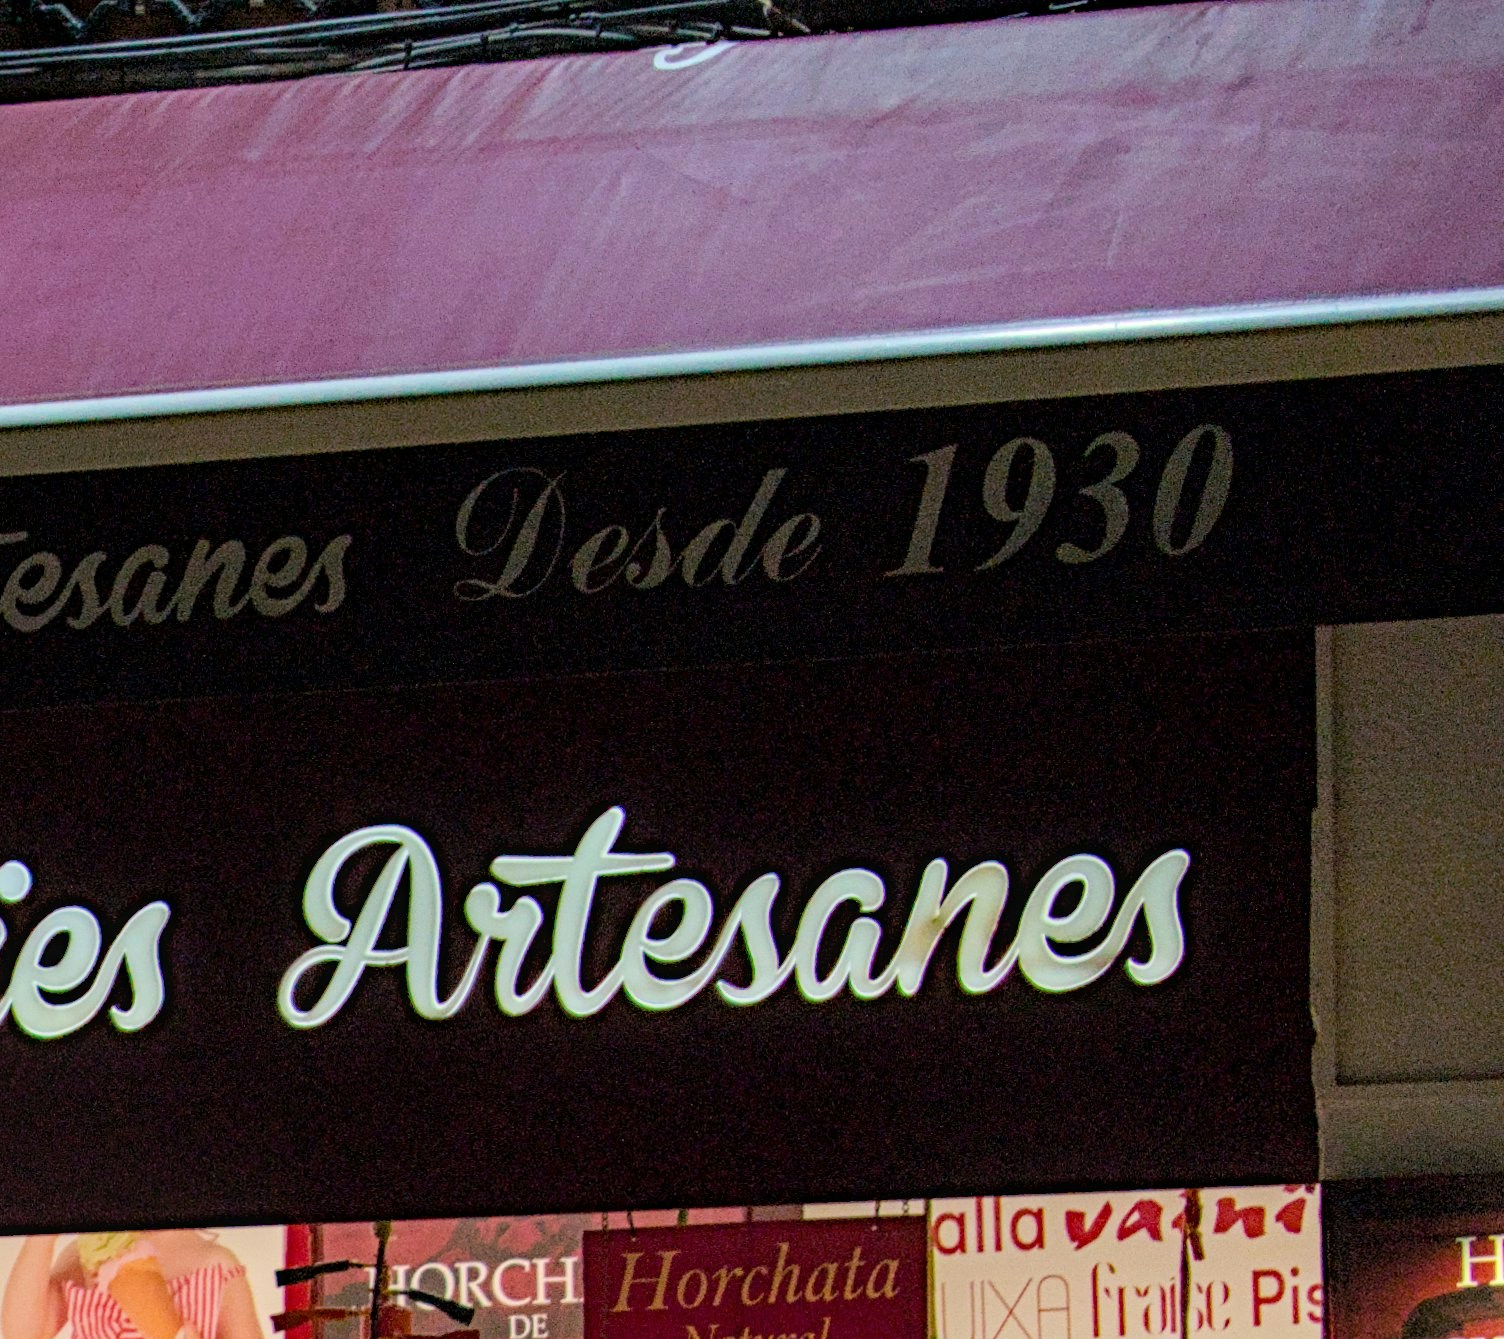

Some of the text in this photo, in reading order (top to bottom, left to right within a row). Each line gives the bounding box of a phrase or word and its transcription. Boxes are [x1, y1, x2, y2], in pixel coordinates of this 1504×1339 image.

[453, 465, 824, 602] Desde
[885, 422, 1236, 578] 1930
[275, 804, 1193, 1031] Artesanes
[933, 1196, 1046, 1256] alla
[365, 1254, 584, 1310] HORCH
[610, 1242, 901, 1314] Horchata
